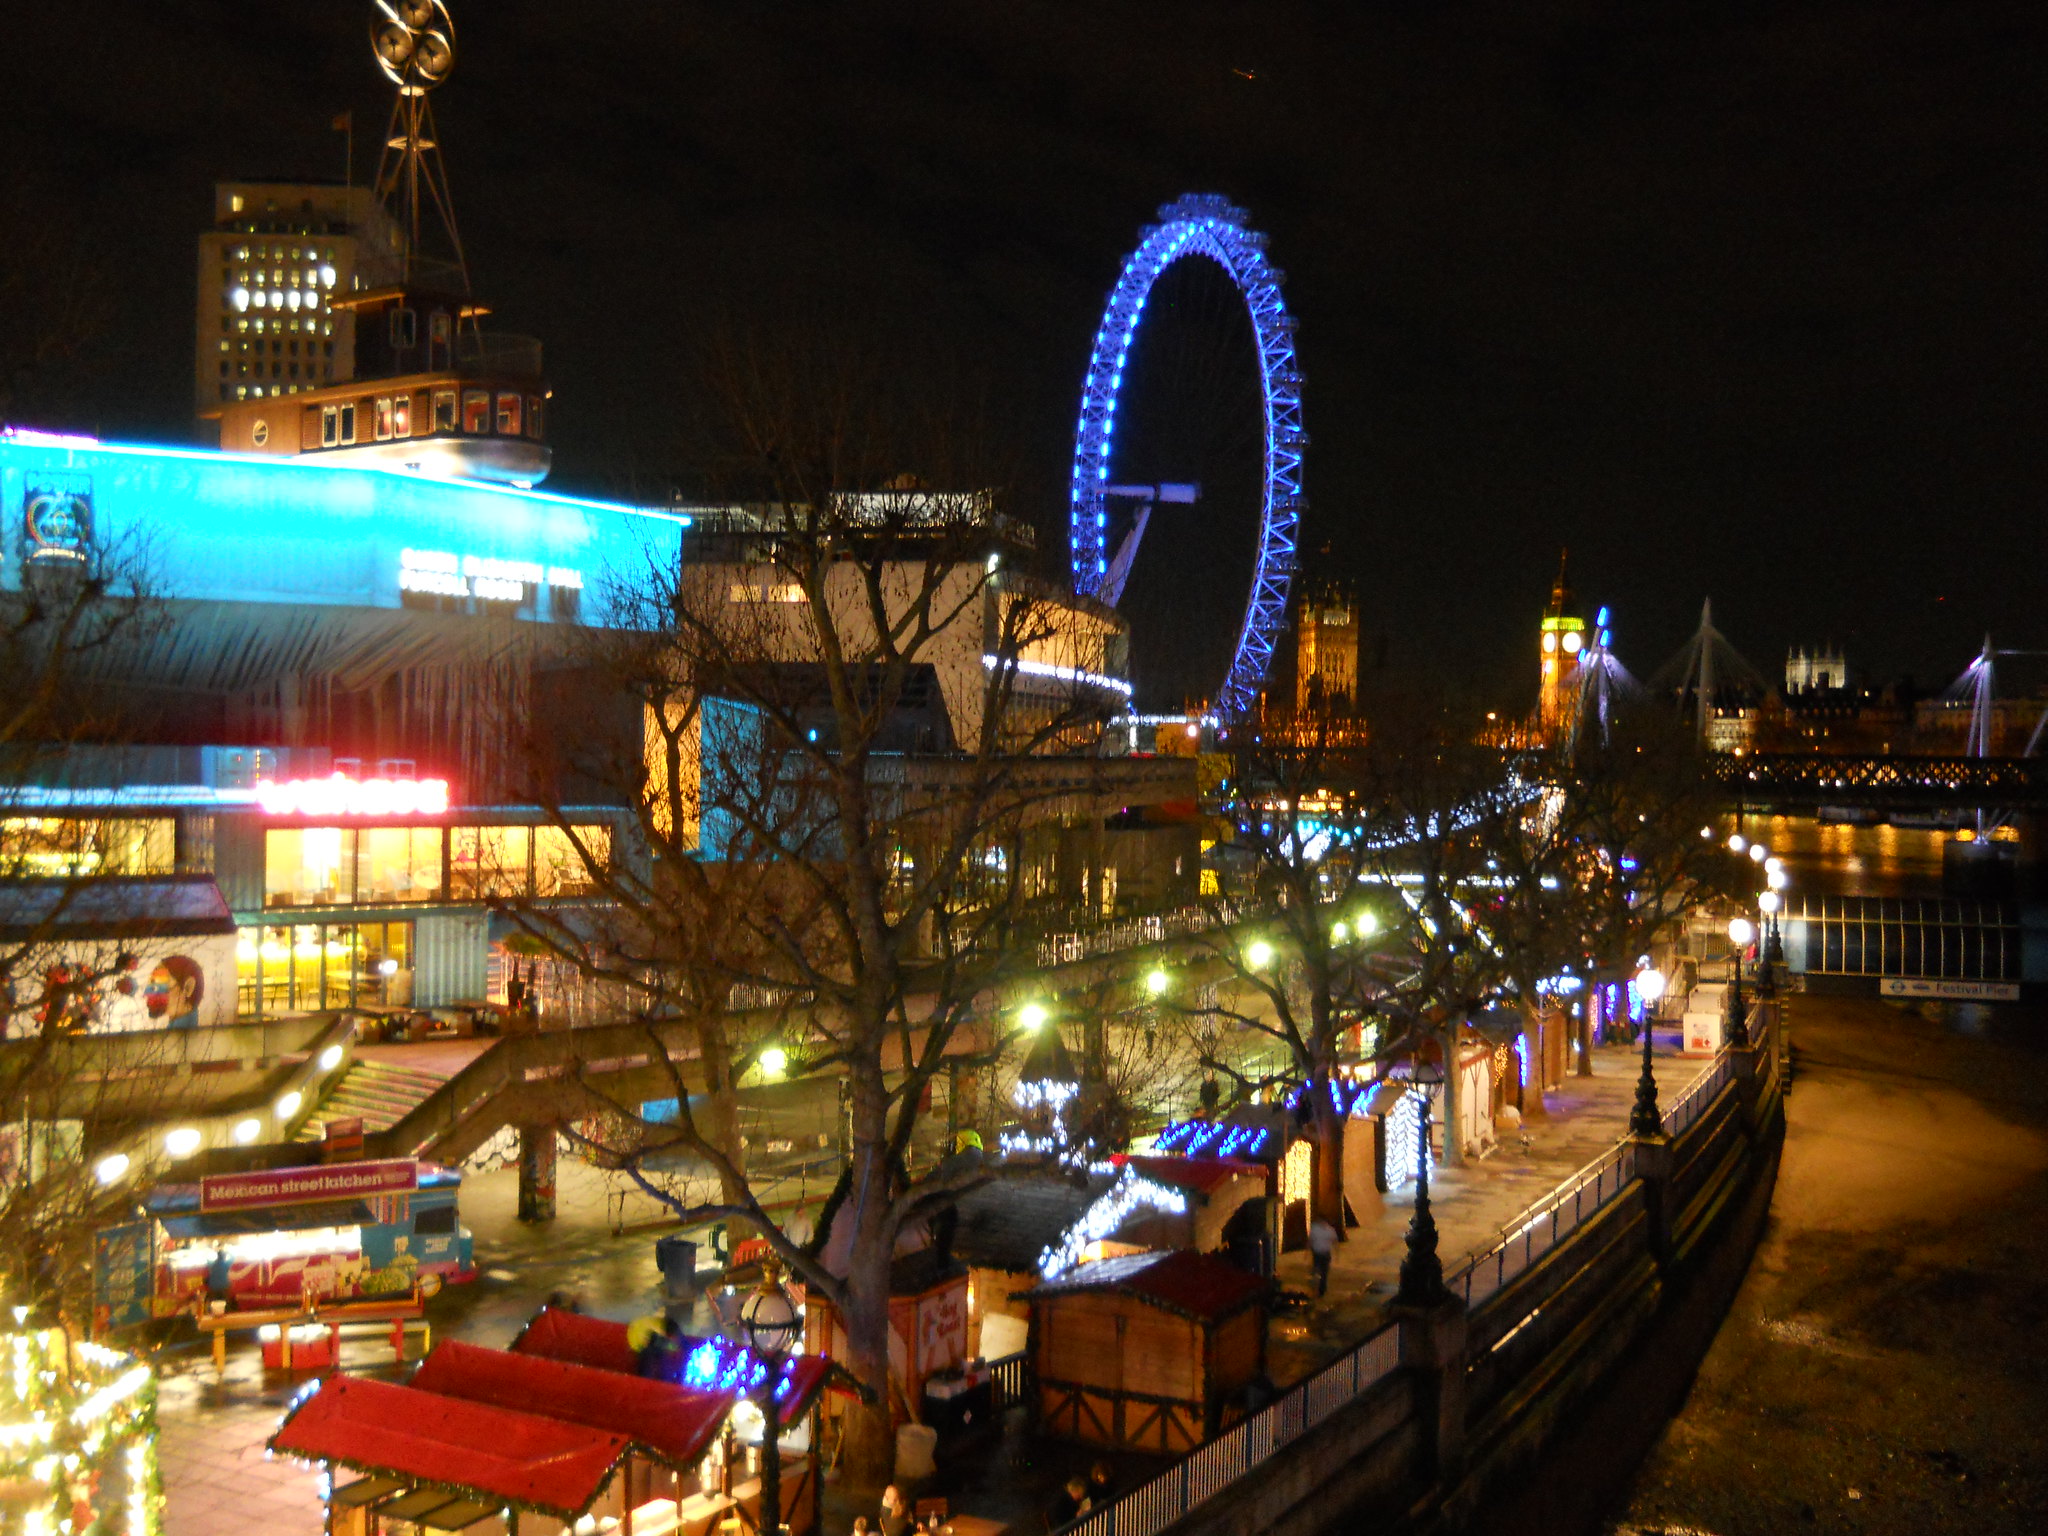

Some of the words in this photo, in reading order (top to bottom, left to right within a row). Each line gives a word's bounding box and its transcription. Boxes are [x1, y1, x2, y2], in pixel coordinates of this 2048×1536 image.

[1936, 982, 1982, 994] Festival
[210, 1184, 278, 1200] Mexican
[281, 1178, 322, 1193] street
[323, 1174, 382, 1188] kitchen
